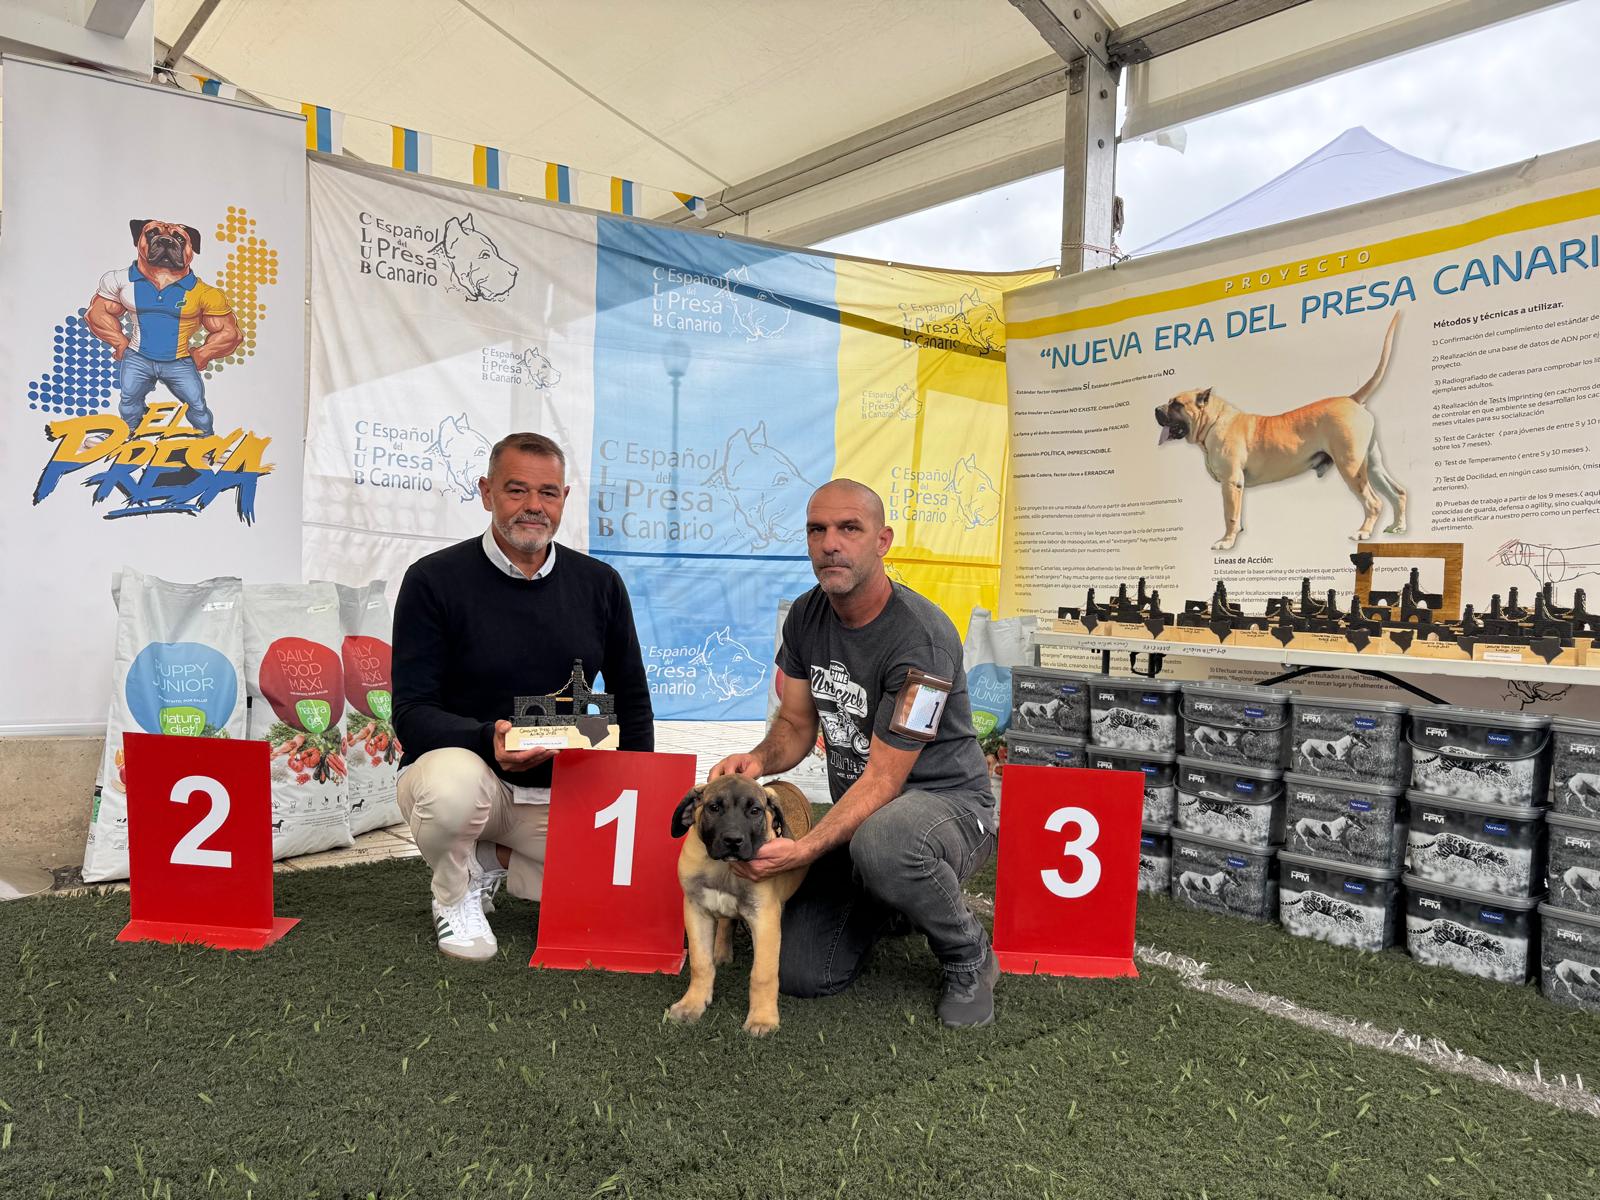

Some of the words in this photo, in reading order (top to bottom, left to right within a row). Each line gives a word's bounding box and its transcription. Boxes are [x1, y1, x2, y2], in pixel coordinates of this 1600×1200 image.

[376, 218, 439, 243] Español
[377, 237, 437, 270] Presa
[375, 261, 438, 287] Canario
[668, 268, 723, 289] Español
[1224, 250, 1372, 293] PROYECTO
[669, 291, 722, 315] Presa
[1154, 322, 1215, 352] ERA
[1227, 305, 1287, 339] DEL
[1300, 276, 1417, 324] PRESA
[1433, 234, 1598, 295] CANARI
[911, 303, 957, 316] Español
[1433, 317, 1471, 328] Métodos
[1472, 315, 1479, 324] y
[1480, 309, 1519, 321] técnicas
[1528, 302, 1564, 313] utilizar.
[666, 312, 722, 334] Canario
[915, 317, 959, 335] Presa
[1439, 331, 1484, 345] Confirmación
[1485, 330, 1495, 338] del
[1496, 325, 1543, 336] cumplimiento
[1545, 321, 1556, 329] del
[1557, 317, 1589, 327] estándar
[915, 334, 960, 350] Canario
[1440, 351, 1477, 361] Realización
[1529, 340, 1550, 348] datos
[1579, 334, 1591, 342] por
[490, 348, 522, 361] Español
[490, 361, 522, 374] Presa
[1442, 374, 1488, 385] Radiografiado
[1499, 369, 1525, 378] caderas
[1527, 367, 1543, 375] para
[1543, 361, 1581, 371] comprobar
[489, 373, 521, 385] Canario
[1432, 385, 1466, 395] ejemplares
[1441, 400, 1478, 410] Realización
[1489, 396, 1506, 404] Tests
[1507, 392, 1543, 402] Imprinting
[1556, 386, 1591, 395] cachorros
[1441, 409, 1471, 417] controlar
[1496, 402, 1527, 412] ambiente
[1537, 395, 1575, 407] desarrollan
[133, 401, 205, 437] EL
[1432, 419, 1452, 427] meses
[1454, 417, 1475, 425] vitales
[1476, 415, 1491, 423] para
[1501, 409, 1545, 419] socialización
[372, 422, 433, 443] Español
[626, 442, 718, 470] Español
[1432, 443, 1450, 451] sobre
[372, 446, 433, 471] Presa
[1468, 454, 1516, 464] Temperamento
[32, 414, 277, 527] PRESA
[369, 467, 432, 491] Canario
[903, 467, 951, 483] Español
[1443, 475, 1456, 483] Test
[624, 479, 713, 513] Presa
[903, 488, 948, 507] Presa
[902, 505, 947, 524] Canario
[621, 512, 713, 541] Canario
[1214, 557, 1236, 565] Líneas
[276, 648, 315, 663] DAILY
[649, 645, 701, 660] Español
[154, 659, 209, 679] PUPPY
[281, 662, 323, 677] FOOD
[152, 676, 215, 694] JUNIOR
[163, 711, 201, 725] natura
[298, 703, 327, 716] natura
[925, 701, 939, 729] 1
[169, 775, 232, 869] 2
[594, 789, 639, 886] 1
[1040, 806, 1102, 899] 3
